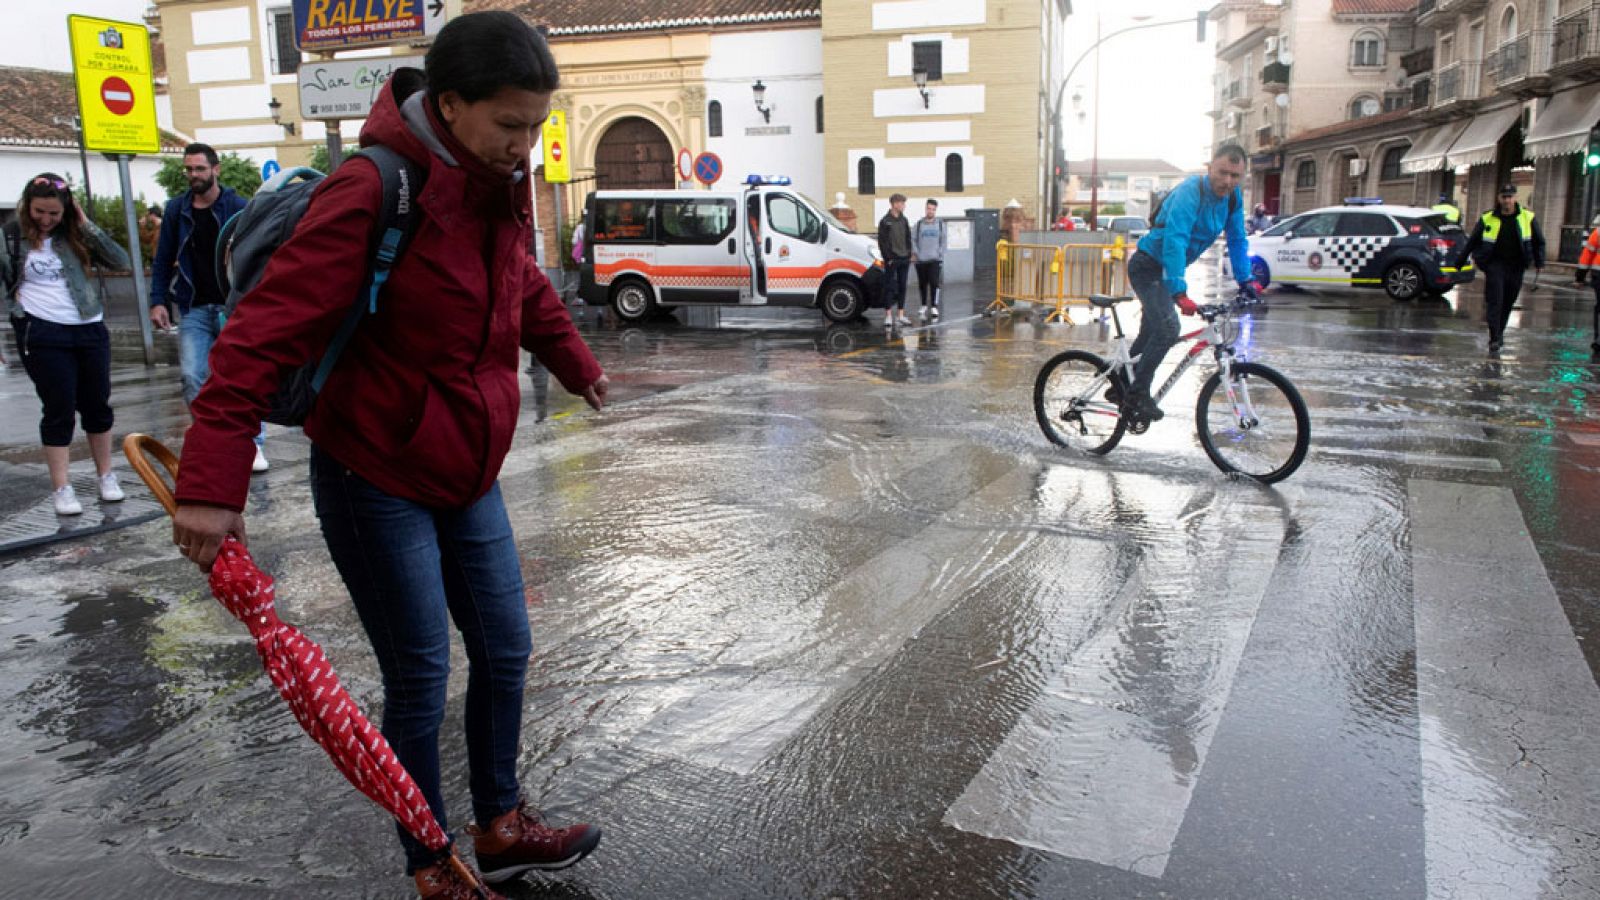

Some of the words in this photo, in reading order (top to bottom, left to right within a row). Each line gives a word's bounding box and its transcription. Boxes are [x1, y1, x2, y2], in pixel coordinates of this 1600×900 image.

[306, 0, 415, 29] RALLYE
[308, 26, 340, 38] TODOS
[342, 24, 362, 34] LOS
[364, 18, 416, 31] PERMISOS
[88, 60, 103, 68] POR
[95, 52, 131, 63] CONTROL
[303, 68, 350, 91] San
